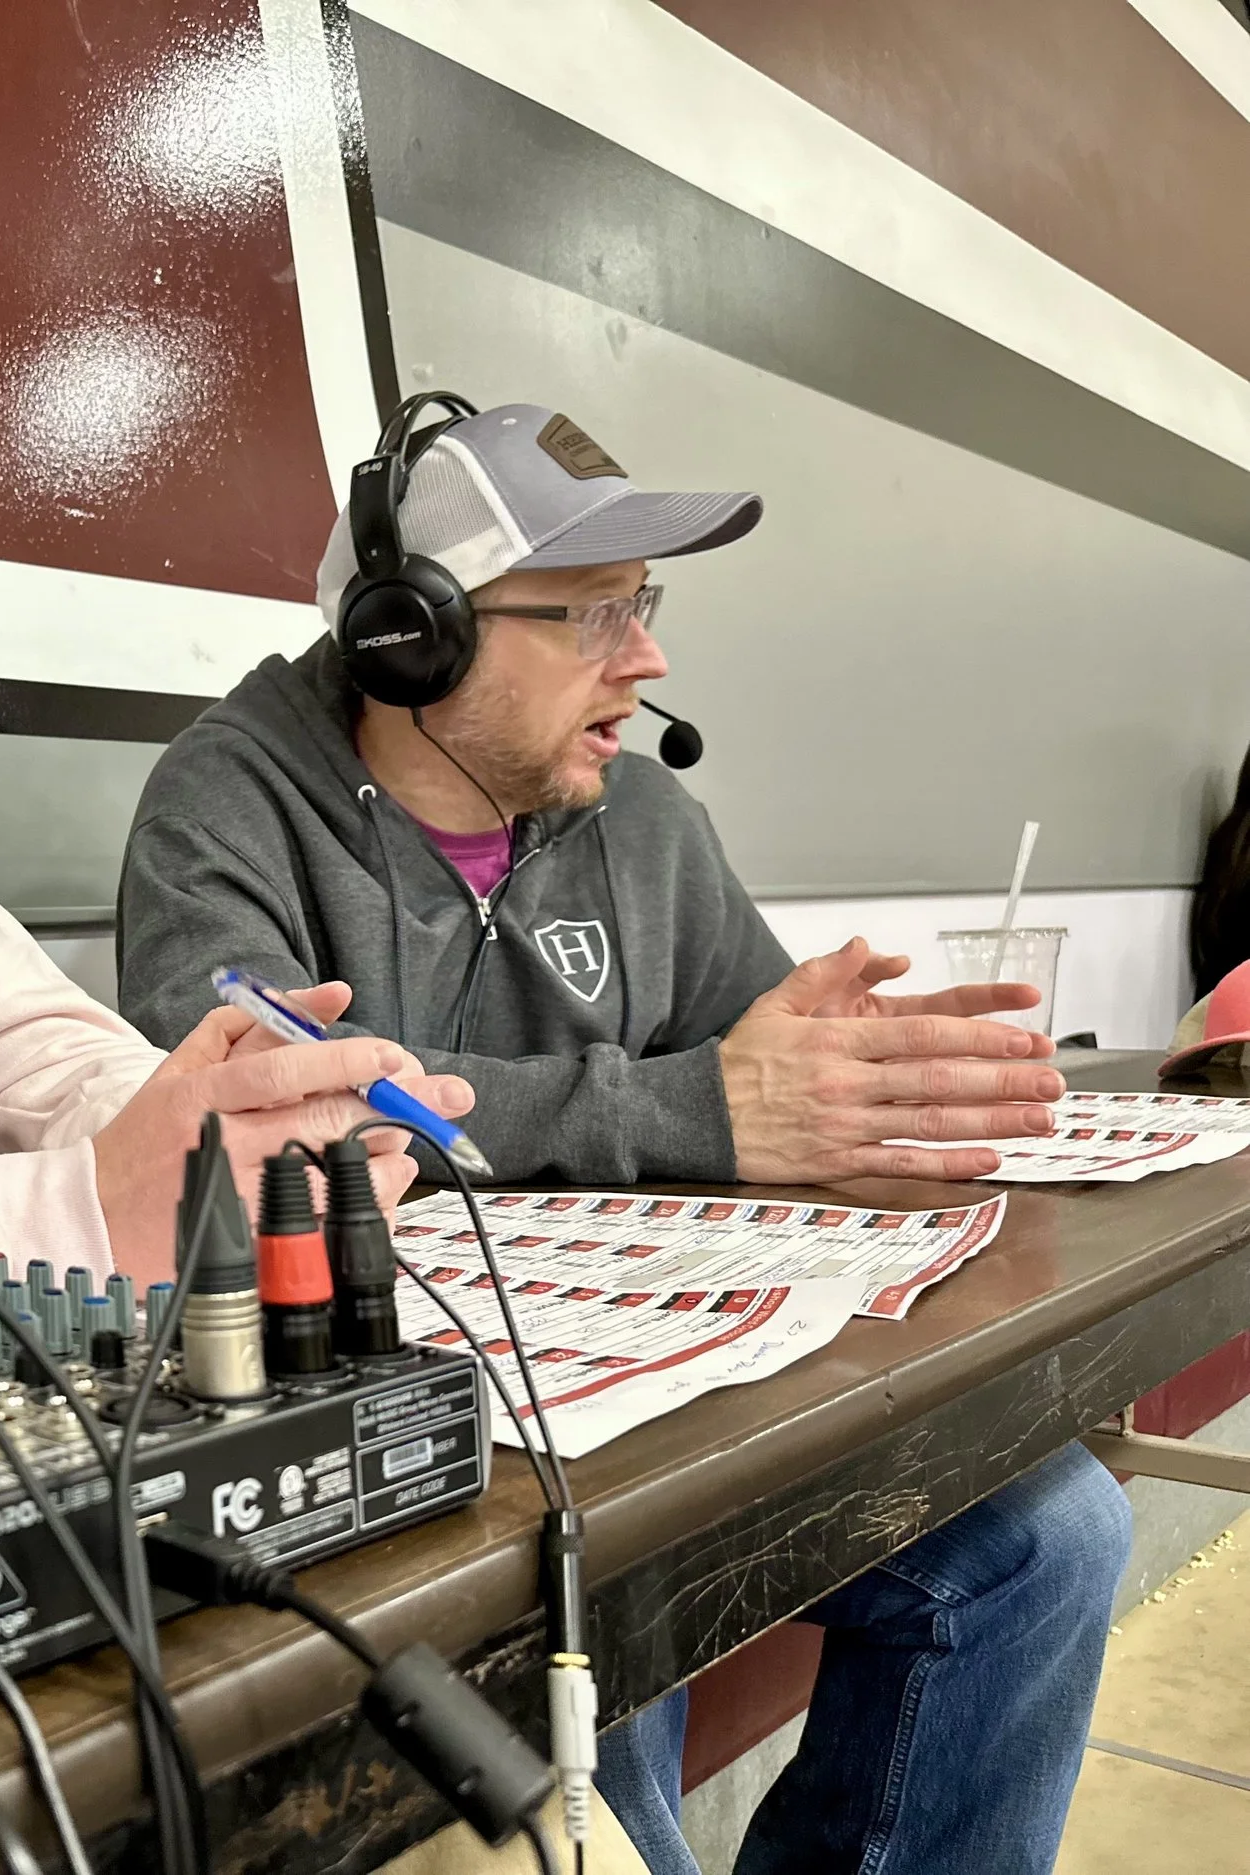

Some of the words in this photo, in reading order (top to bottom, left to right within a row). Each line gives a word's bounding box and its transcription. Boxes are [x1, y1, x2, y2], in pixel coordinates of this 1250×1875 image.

[548, 930, 600, 975] H
[395, 1485, 420, 1507] DATE
[421, 1476, 447, 1495] CODE
